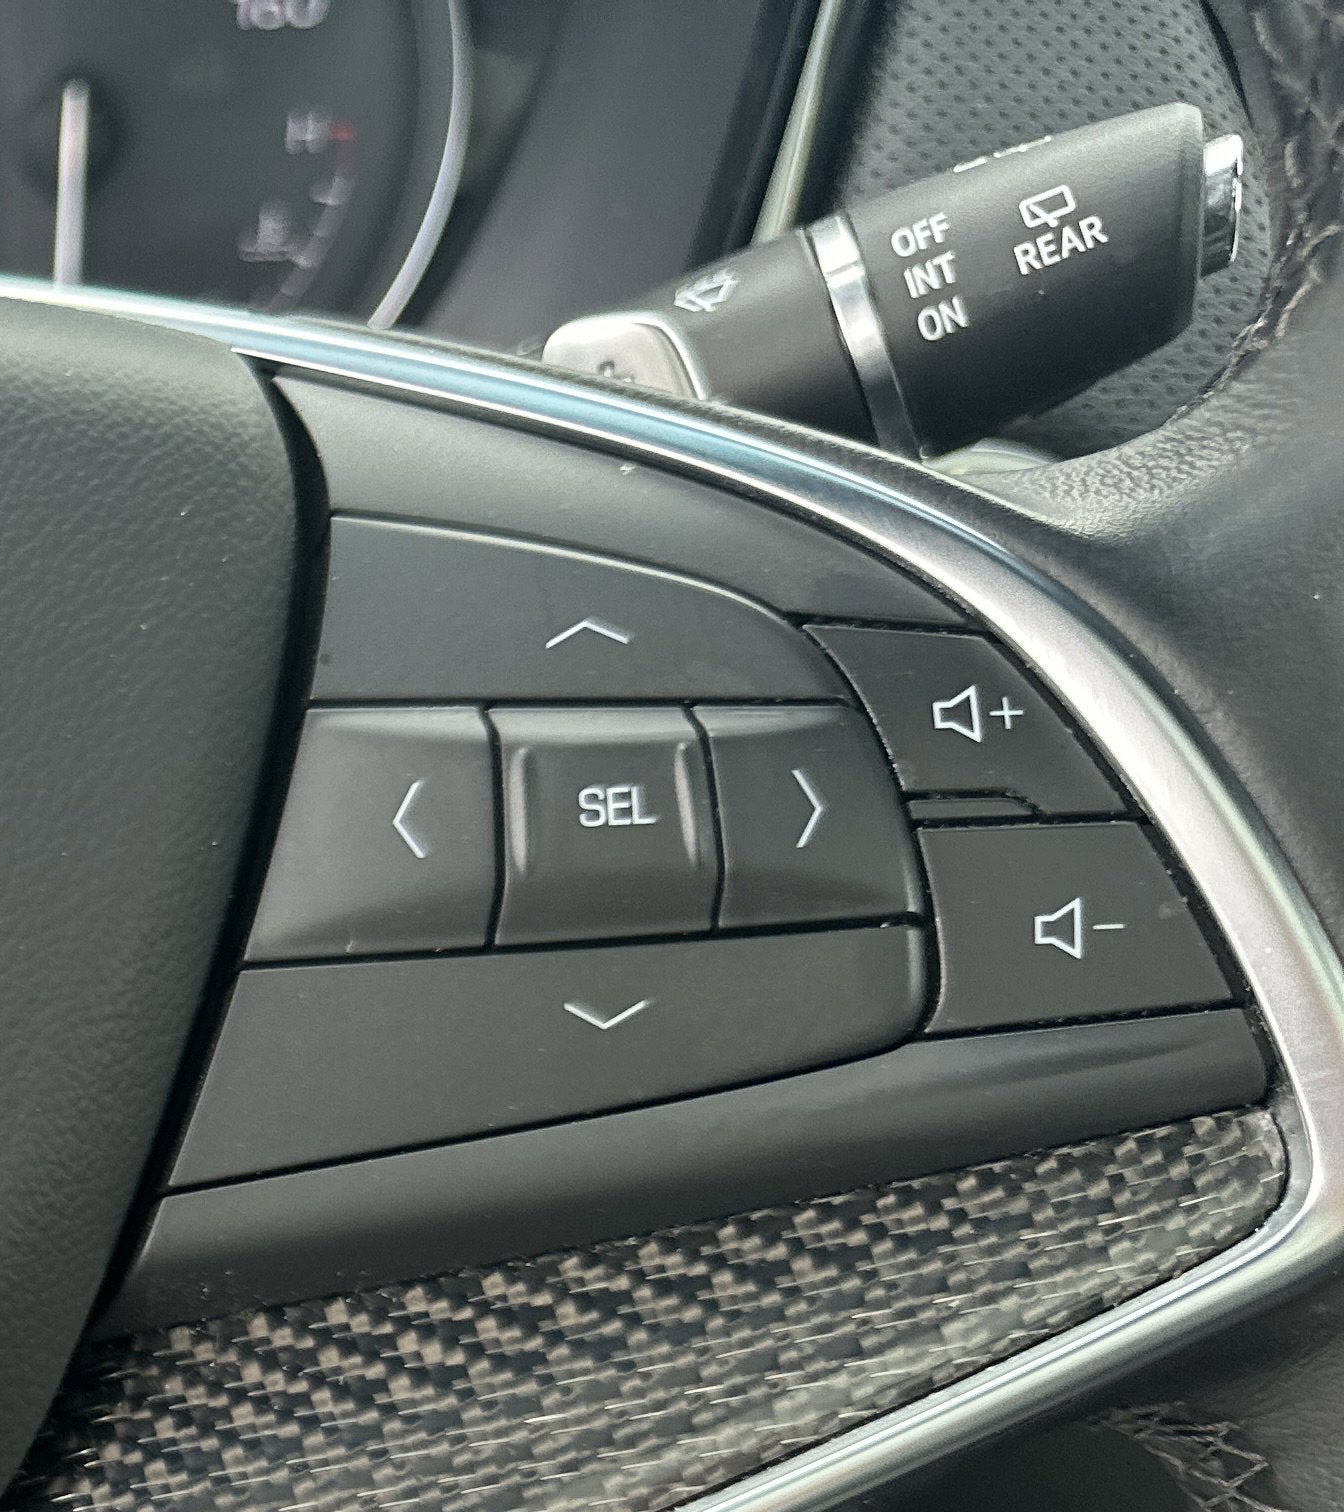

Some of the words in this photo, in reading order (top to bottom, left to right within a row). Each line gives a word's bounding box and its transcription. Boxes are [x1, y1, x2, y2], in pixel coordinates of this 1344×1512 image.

[891, 211, 951, 258] OFF
[1013, 214, 1110, 276] REAR
[903, 250, 957, 299] INT
[916, 295, 970, 342] ON
[577, 785, 658, 828] SEL
